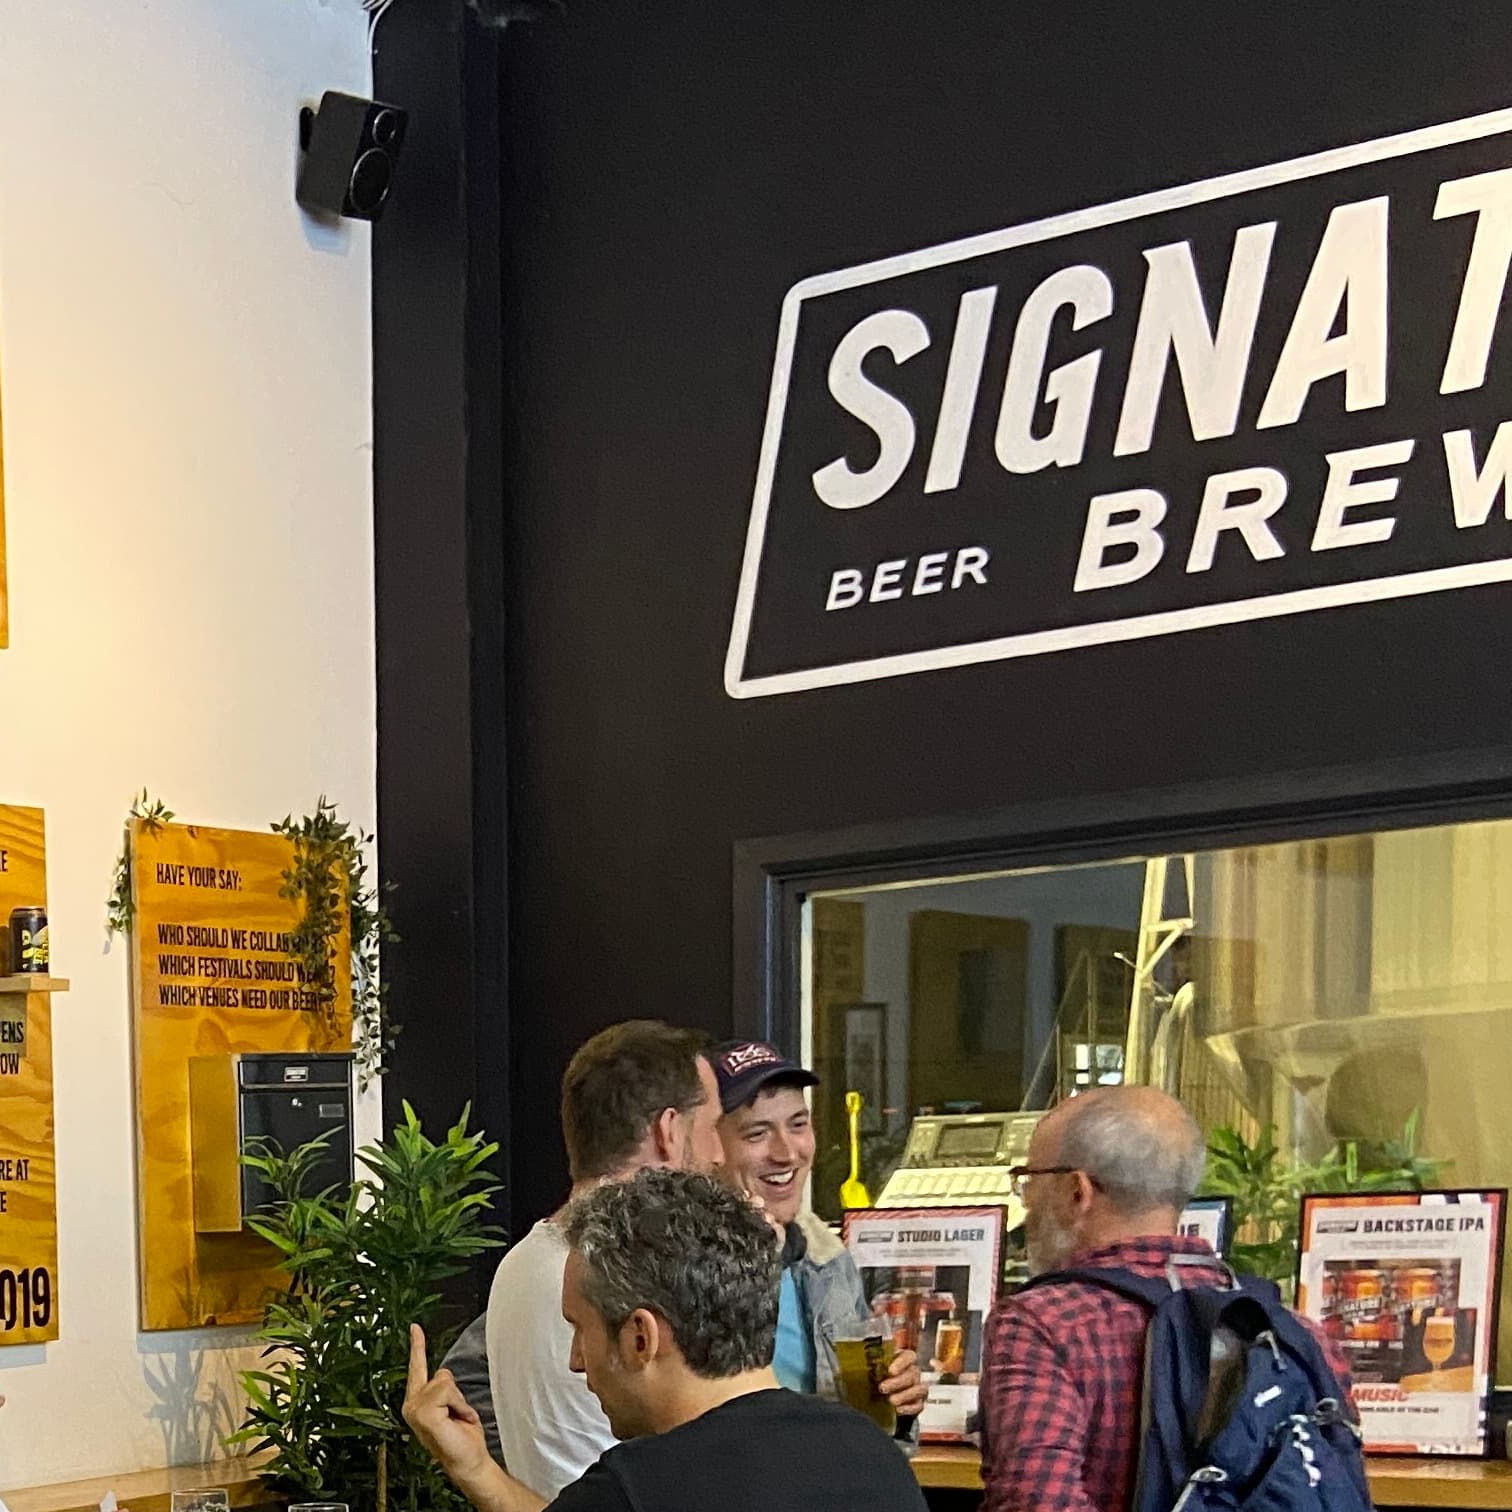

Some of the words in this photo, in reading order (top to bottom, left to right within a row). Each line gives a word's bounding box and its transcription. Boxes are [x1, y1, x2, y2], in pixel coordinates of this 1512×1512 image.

[812, 169, 1512, 510] SIGNAT
[826, 548, 989, 611] BEER
[156, 863, 185, 885] HAVE
[188, 866, 216, 889] YOUR
[219, 869, 242, 891] SAY:
[158, 924, 183, 947] WHO
[187, 927, 228, 949] SHOULD
[232, 930, 247, 950] WE
[250, 931, 288, 952] COLLAB
[159, 955, 195, 977] WHICH
[198, 958, 252, 981] FESTIVALS
[255, 960, 294, 983] SHOULD
[160, 985, 195, 1006] WHICH
[199, 987, 238, 1007] VENUES
[241, 988, 267, 1008] NEED
[269, 992, 290, 1009] OUR
[16, 1159, 29, 1180] AT
[897, 1229, 941, 1242] STUDIO
[944, 1229, 984, 1242] LAGER
[1363, 1218, 1454, 1233] BACKSTAGE
[1459, 1217, 1484, 1231] IPA
[1351, 1388, 1409, 1402] MUSIC
